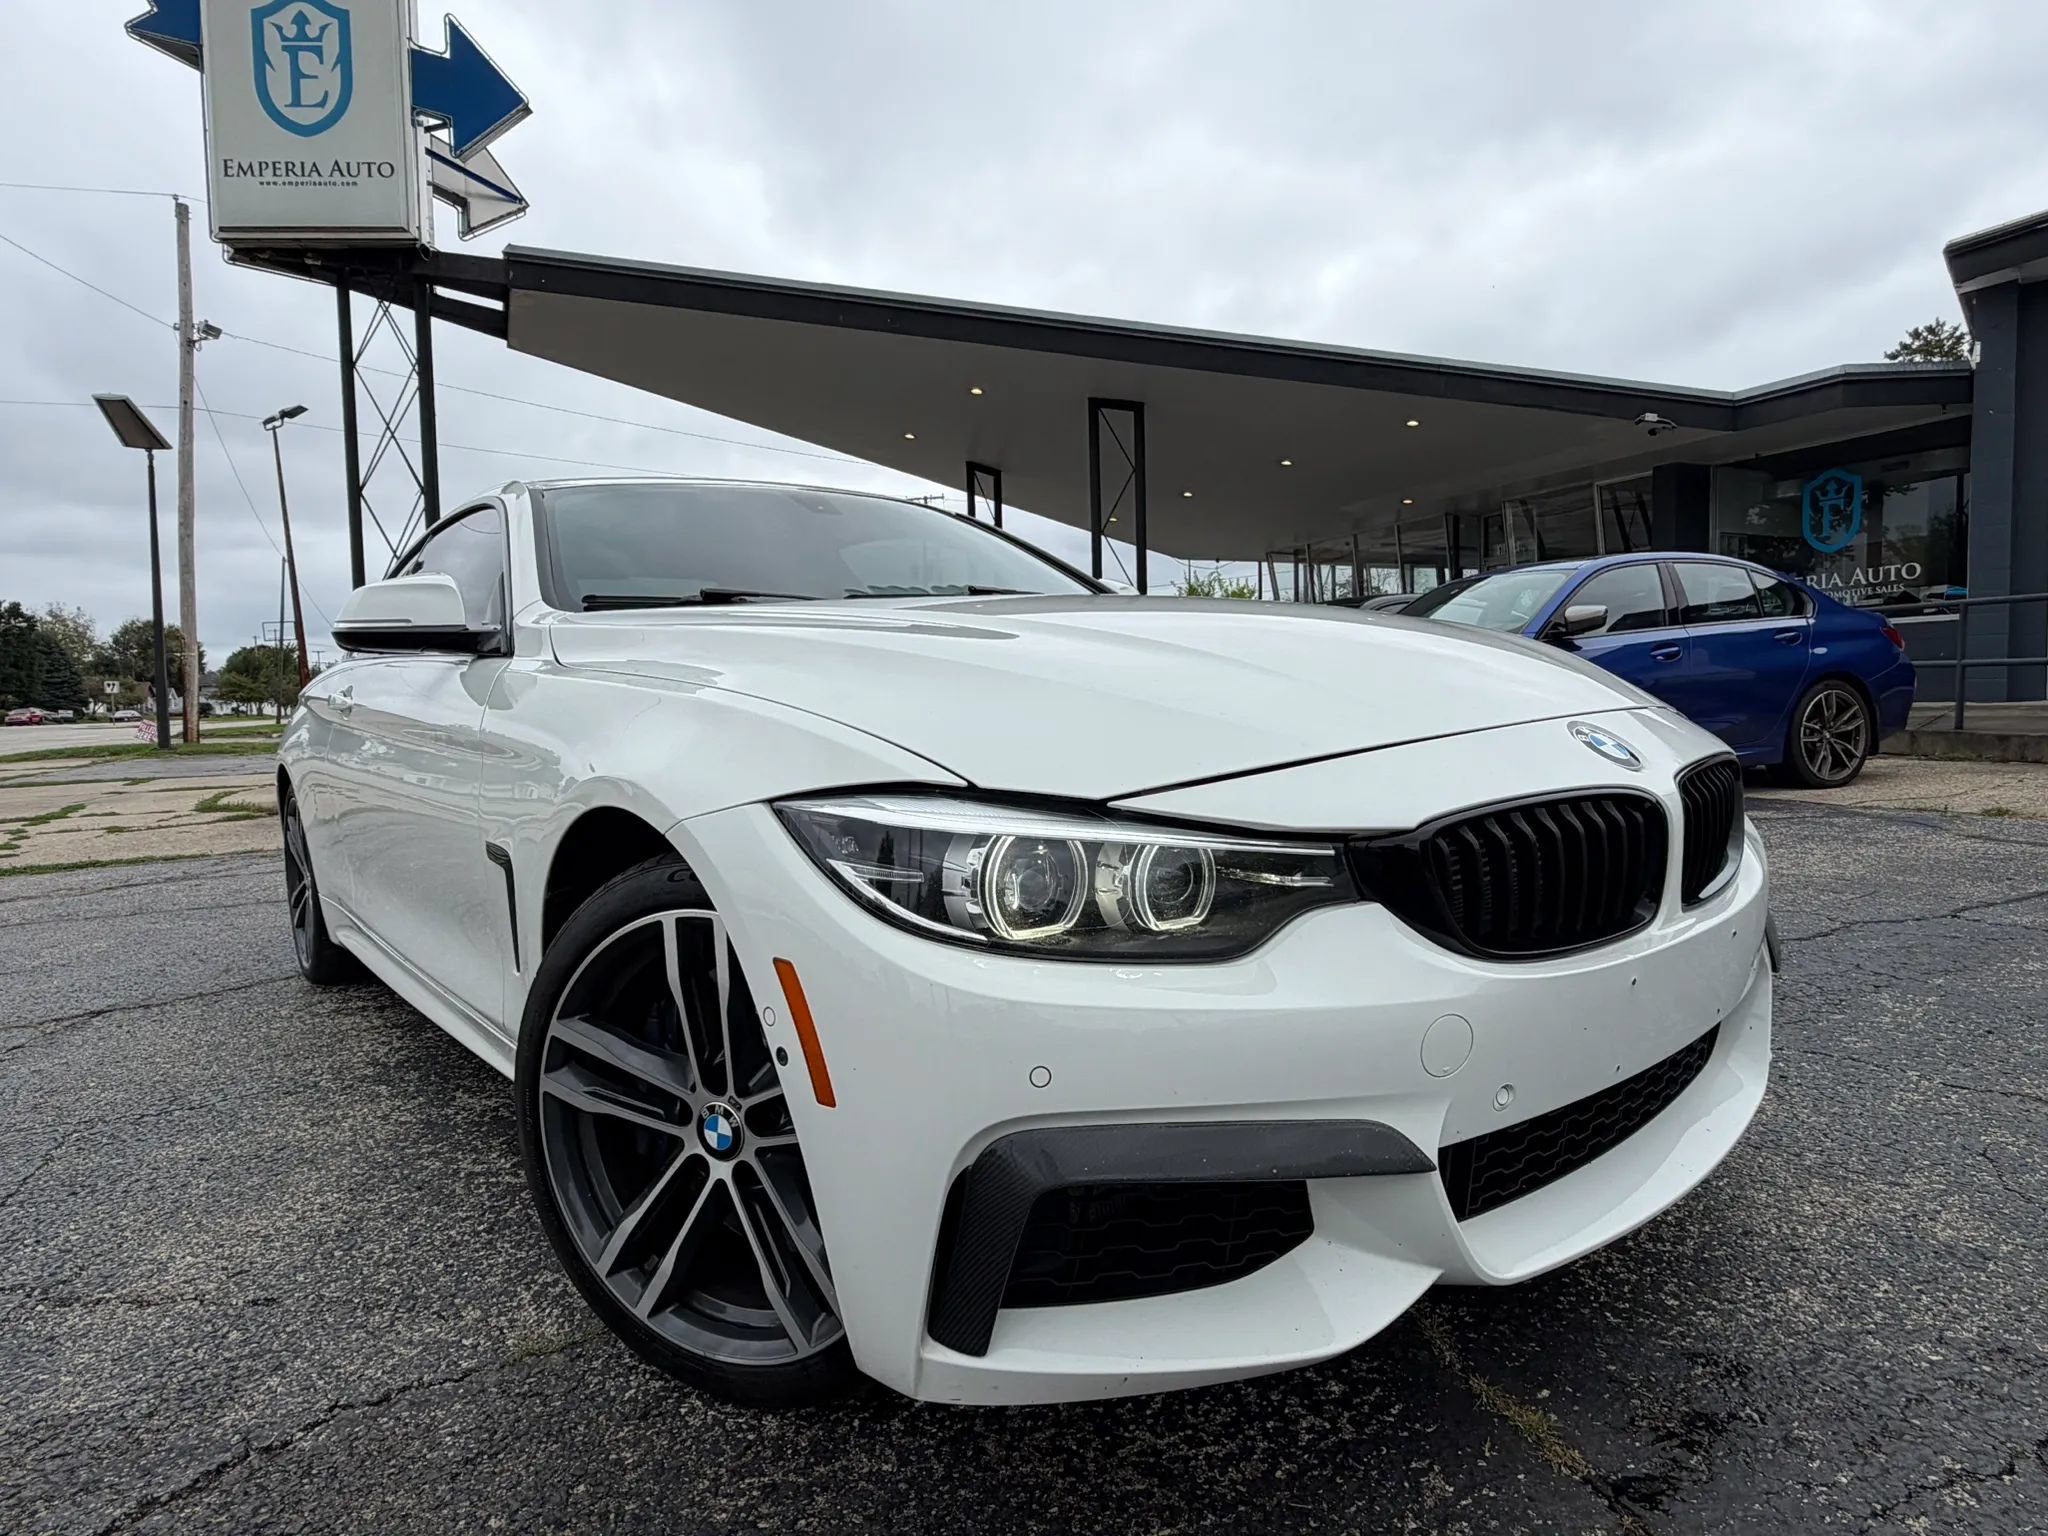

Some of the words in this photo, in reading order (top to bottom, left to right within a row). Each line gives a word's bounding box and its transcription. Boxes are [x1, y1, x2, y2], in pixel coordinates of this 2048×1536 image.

[281, 45, 329, 109] E
[222, 158, 323, 178] EMPERIA
[328, 159, 396, 179] AUTO
[1794, 573, 1843, 589] RIA
[1849, 562, 1922, 586] AUTO
[1825, 585, 1873, 598] OMOTIVE
[1875, 583, 1905, 593] SALES
[701, 1104, 739, 1127] BMW
